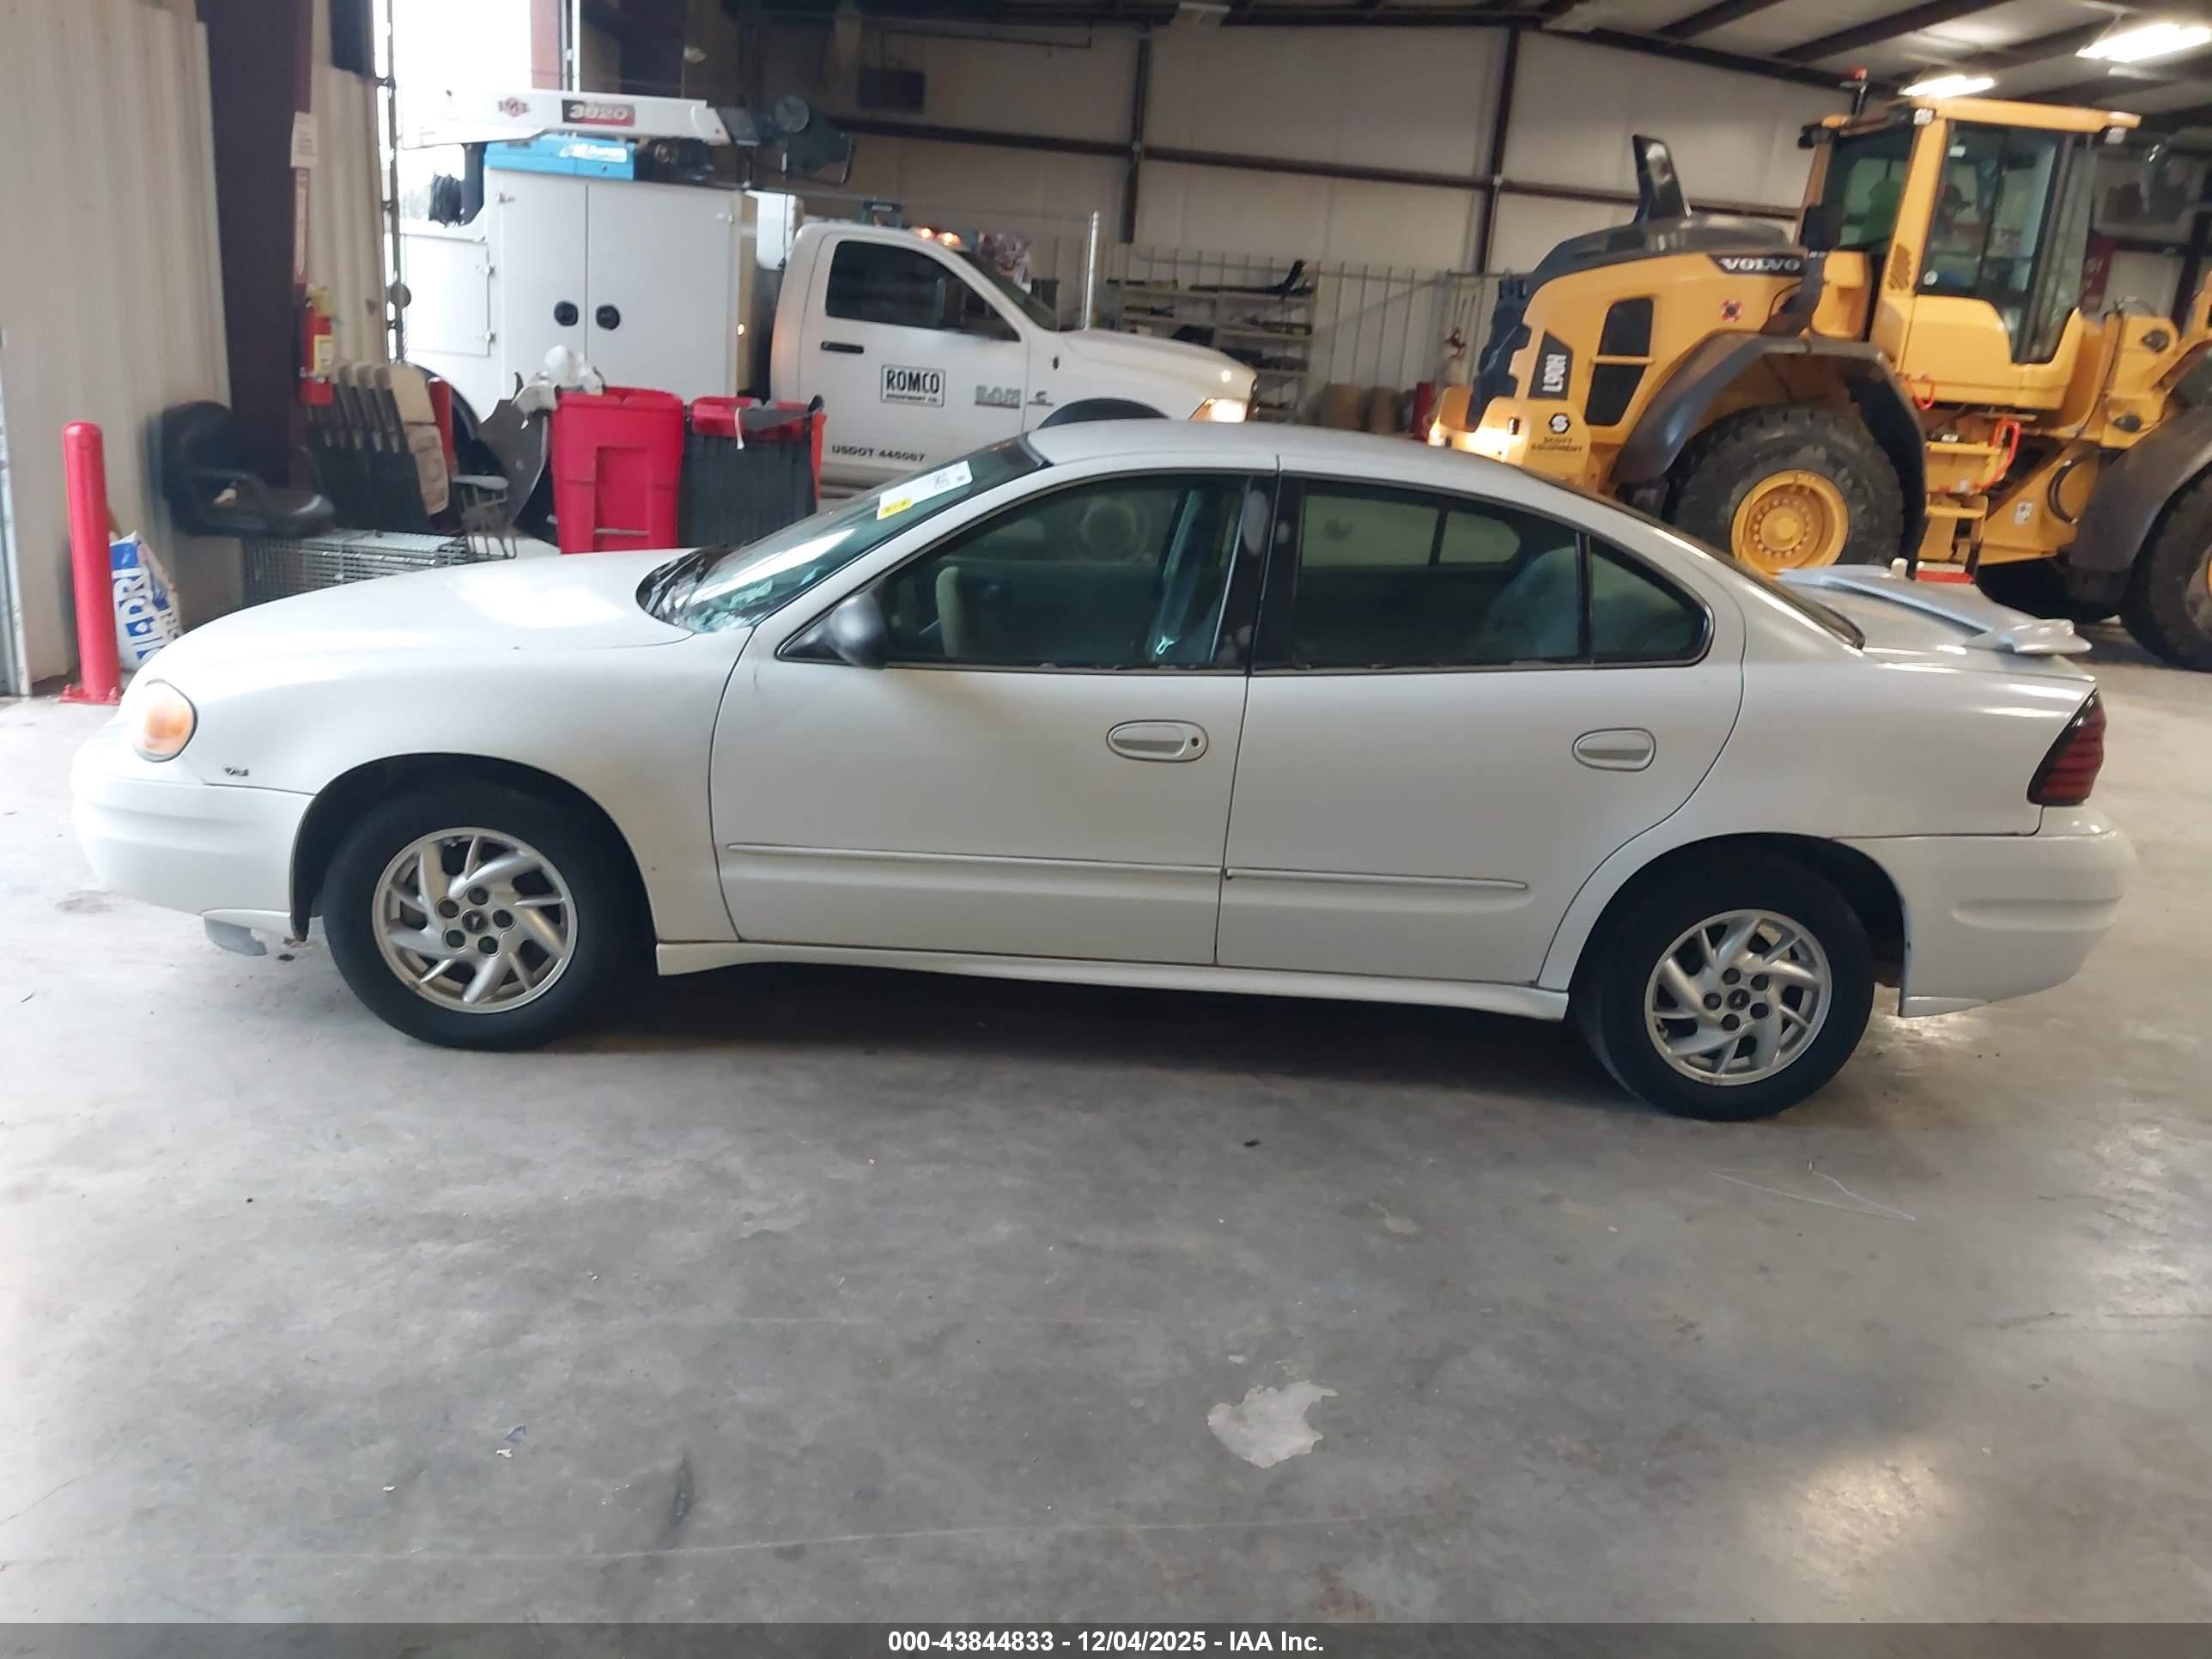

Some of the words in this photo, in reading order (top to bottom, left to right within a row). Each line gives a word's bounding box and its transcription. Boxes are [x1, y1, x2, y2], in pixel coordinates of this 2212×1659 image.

[1718, 257, 1801, 271] VOLVO
[885, 368, 940, 395] ROMCO
[831, 444, 875, 457] USDOT
